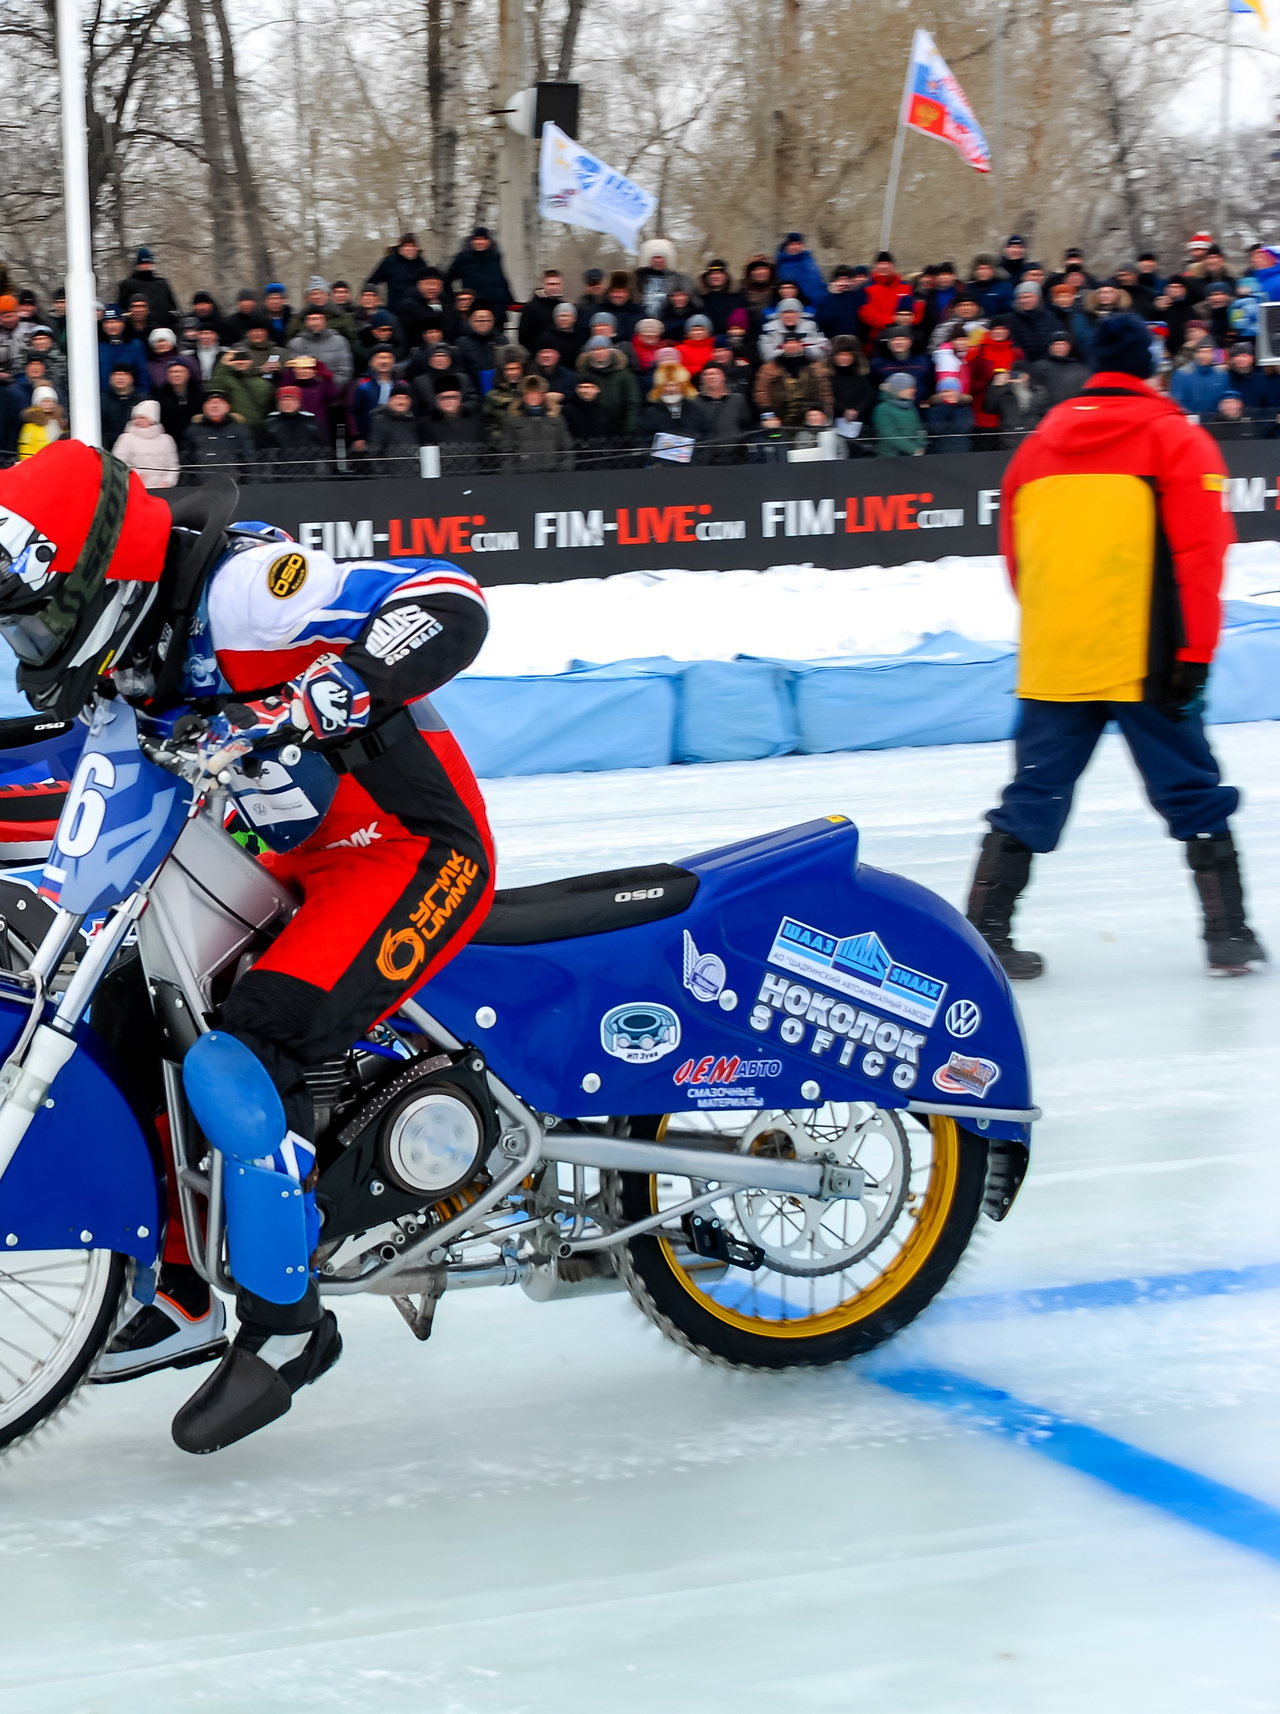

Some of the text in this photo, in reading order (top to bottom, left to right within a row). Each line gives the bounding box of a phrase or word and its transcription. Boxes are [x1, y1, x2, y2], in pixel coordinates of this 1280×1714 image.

[34, 722, 65, 731] OSO
[57, 752, 117, 858] 6
[421, 857, 479, 940] UMMC
[614, 887, 664, 903] OSO
[782, 921, 836, 954] ШААЗ
[890, 967, 942, 998] SHAAZ
[758, 973, 926, 1064] НОКОЛОК
[749, 1004, 918, 1090] SOFICO
[687, 1086, 756, 1098] СМАЗОЧНЫЕ
[697, 1097, 764, 1108] МАТЕРИАЛЫ
